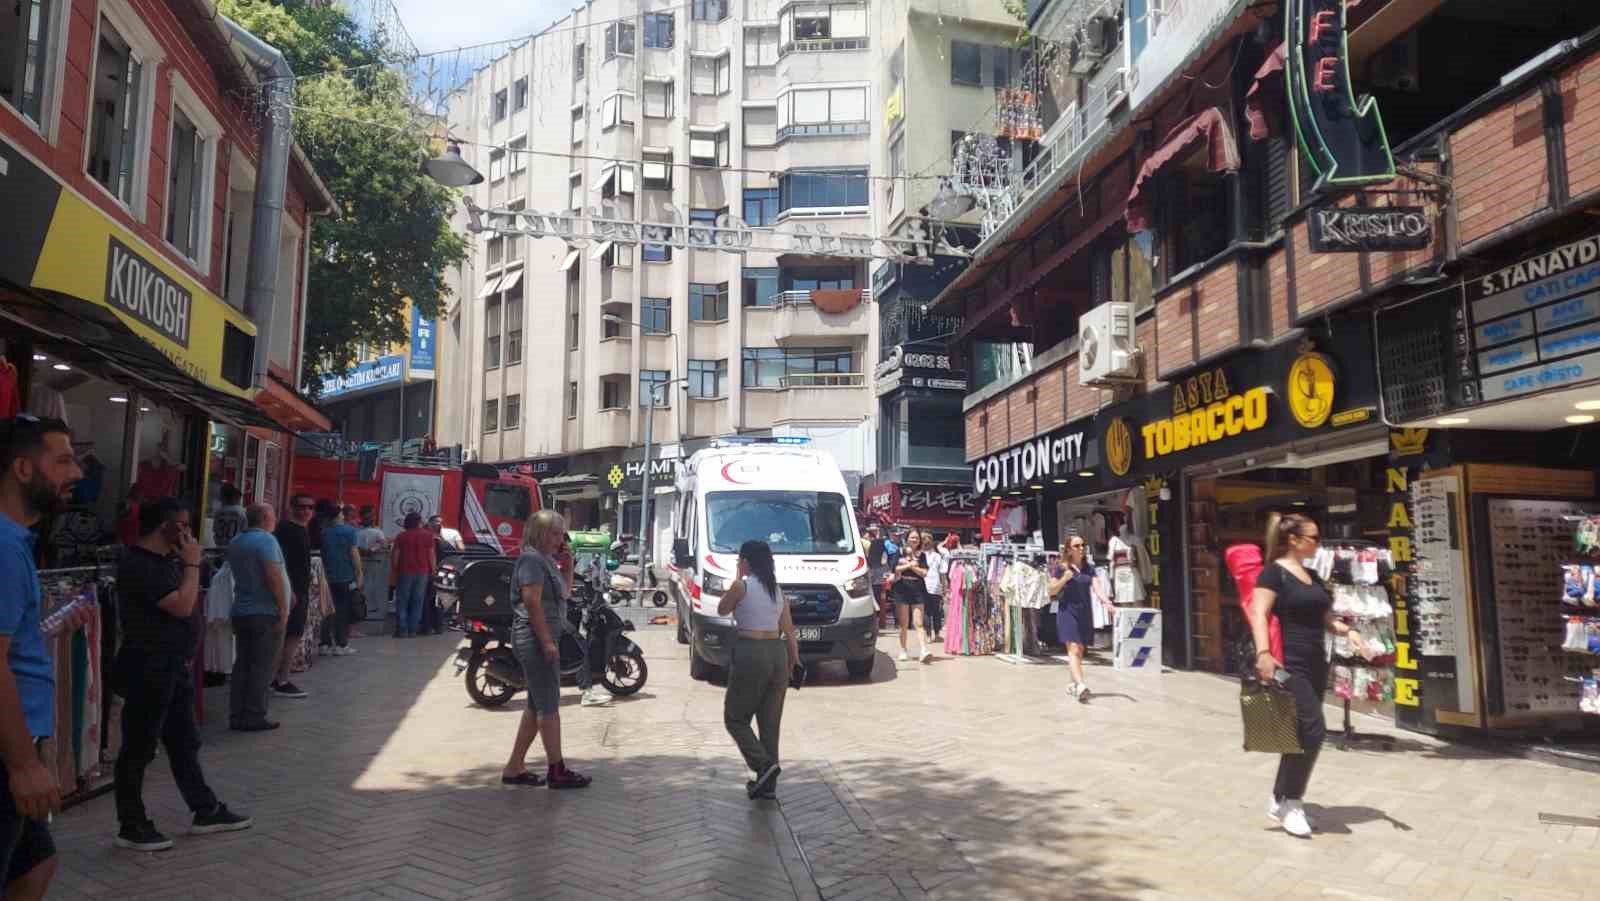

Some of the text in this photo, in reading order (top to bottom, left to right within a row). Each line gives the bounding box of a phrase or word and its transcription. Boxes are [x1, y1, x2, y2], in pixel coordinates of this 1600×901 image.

[110, 246, 189, 341] KOKOSH
[1482, 236, 1600, 295] S.TANAYD
[1172, 367, 1231, 413] ASYA
[1142, 386, 1268, 460] TOBACCO
[975, 431, 1083, 494] COTTON CITY
